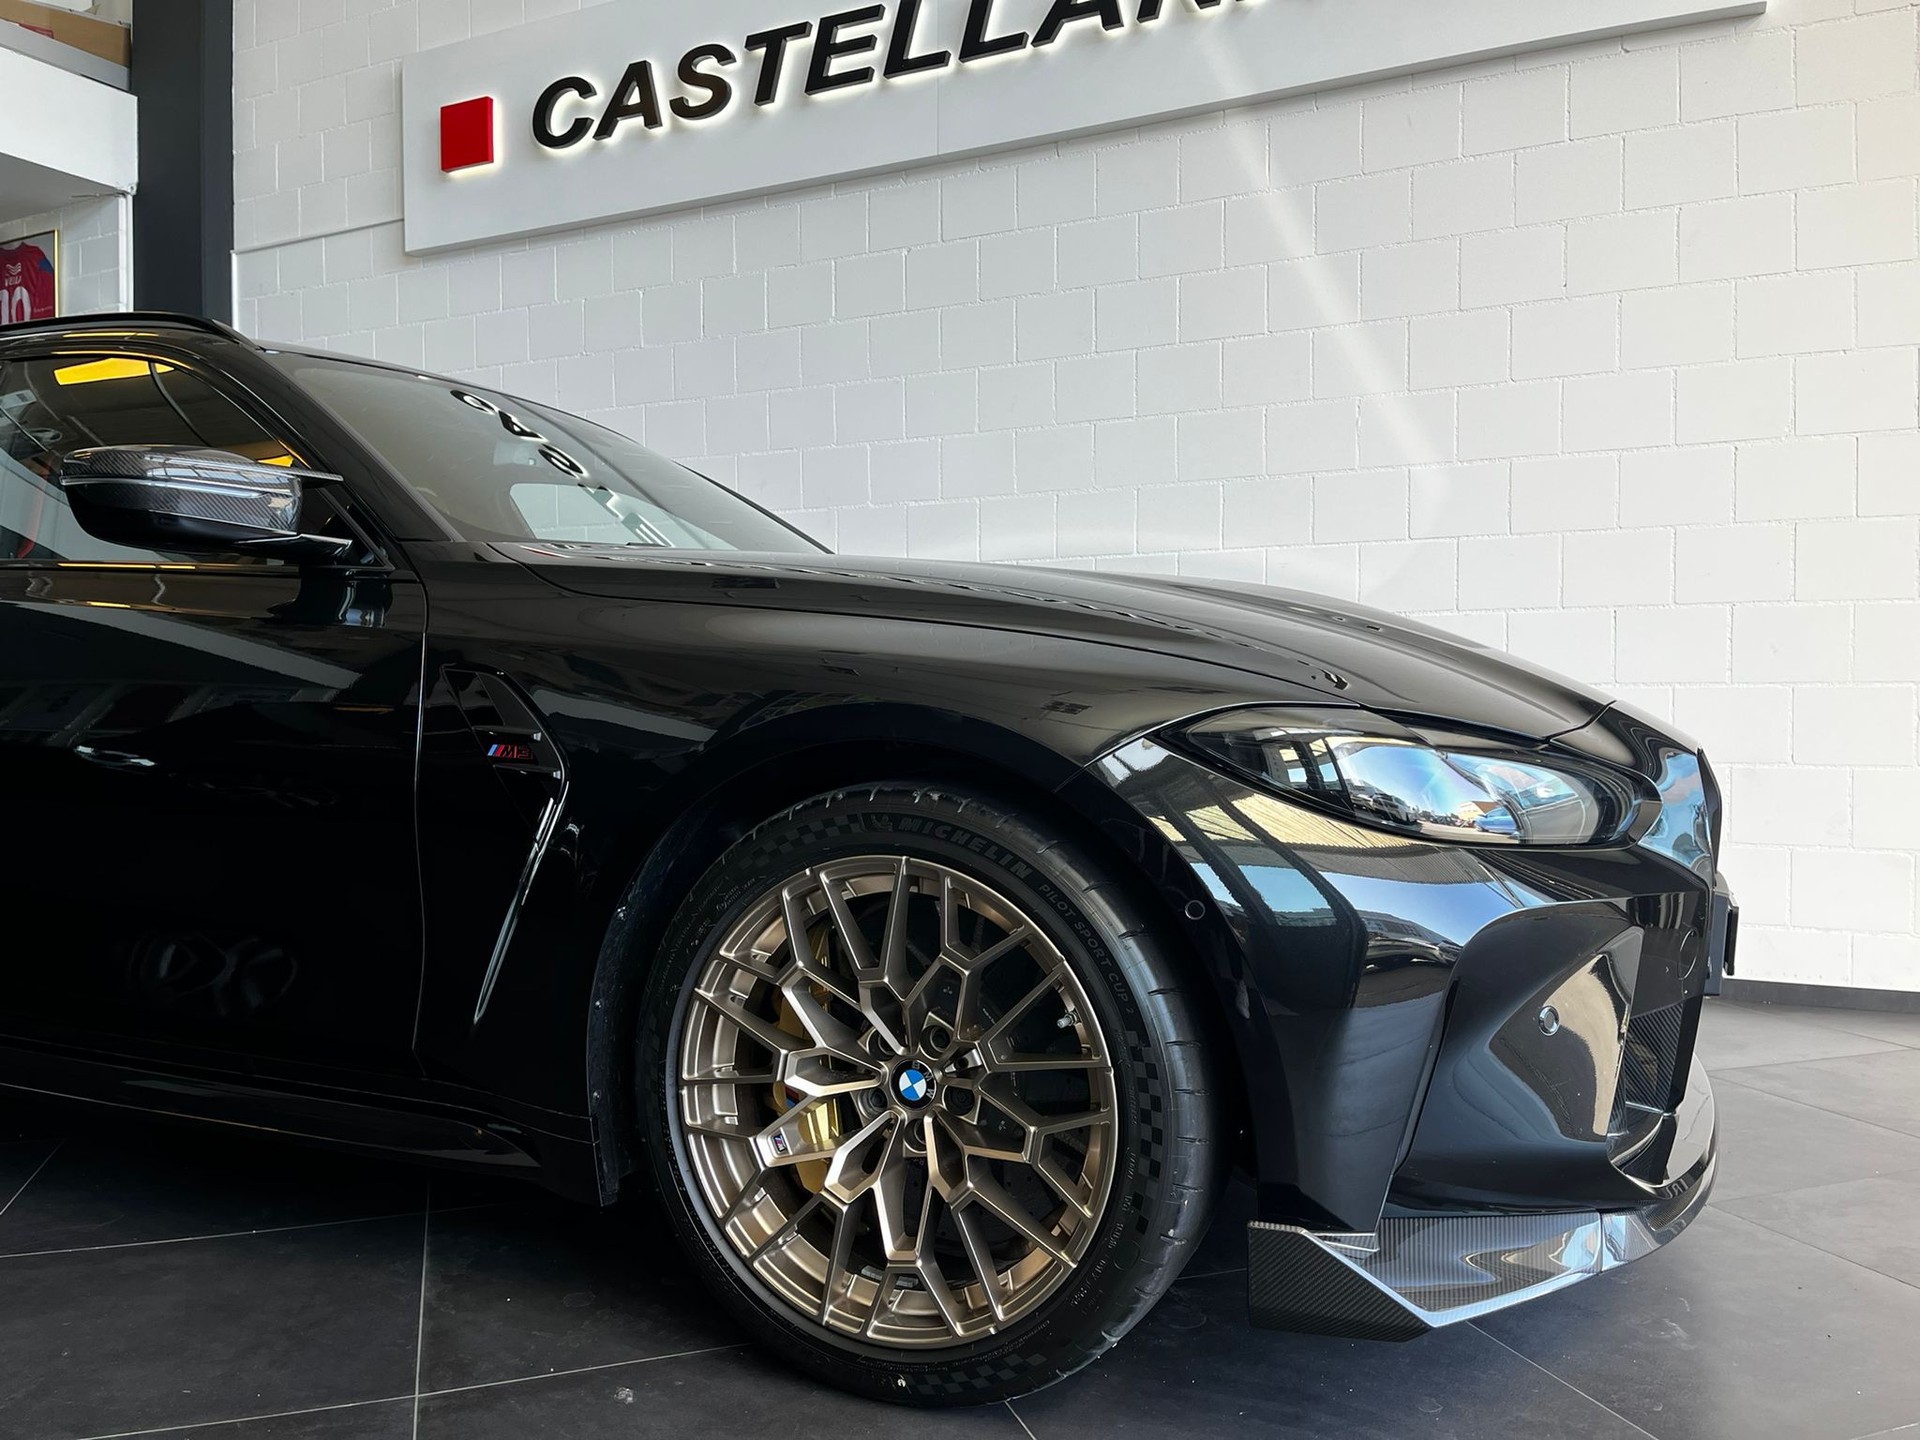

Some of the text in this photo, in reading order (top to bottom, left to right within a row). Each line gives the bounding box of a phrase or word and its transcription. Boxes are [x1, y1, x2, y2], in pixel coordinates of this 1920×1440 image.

[898, 817, 1035, 880] MICHELIN
[1038, 884, 1076, 918] PILOT
[1074, 921, 1113, 968] SPORT
[1108, 972, 1129, 1003] CUP
[1125, 1007, 1135, 1015] 2
[911, 1060, 935, 1099] BMW
